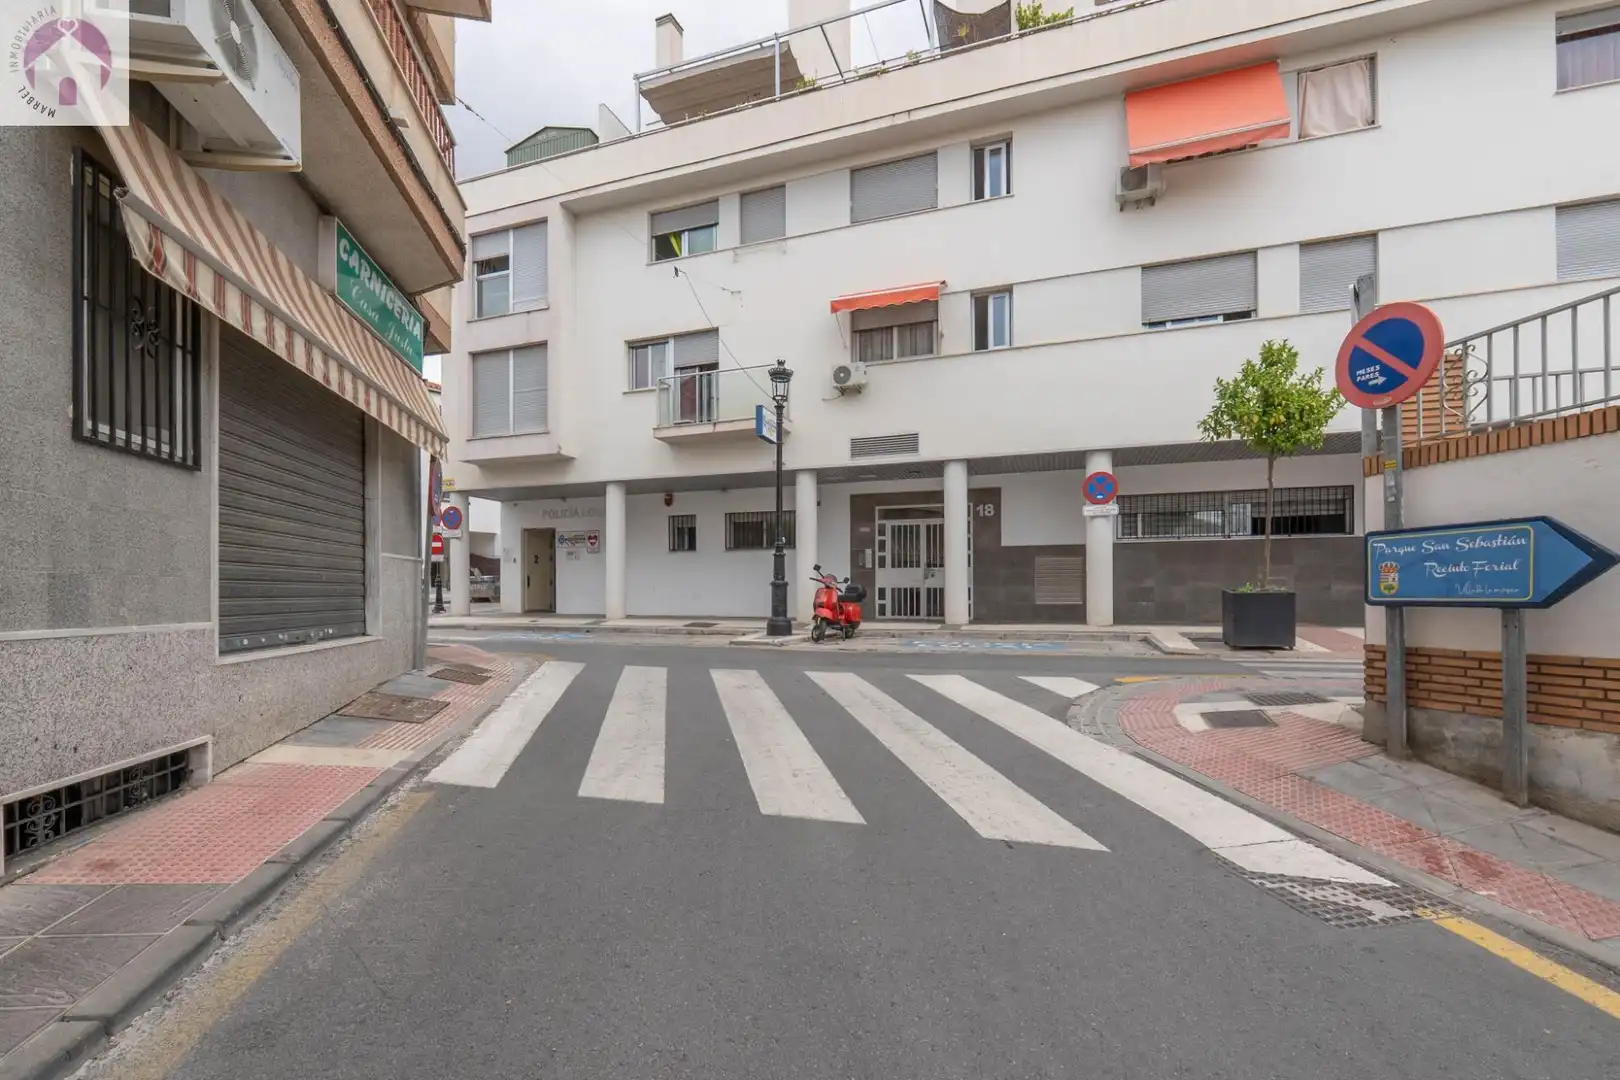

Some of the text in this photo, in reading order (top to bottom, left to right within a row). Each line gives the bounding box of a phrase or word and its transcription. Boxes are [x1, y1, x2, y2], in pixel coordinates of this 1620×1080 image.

[1356, 365, 1380, 376] MESES
[1356, 372, 1380, 382] PARES
[976, 504, 995, 517] 18
[1372, 534, 1527, 560] Parque San Sebastián
[1423, 560, 1520, 578] Recinto Ferial
